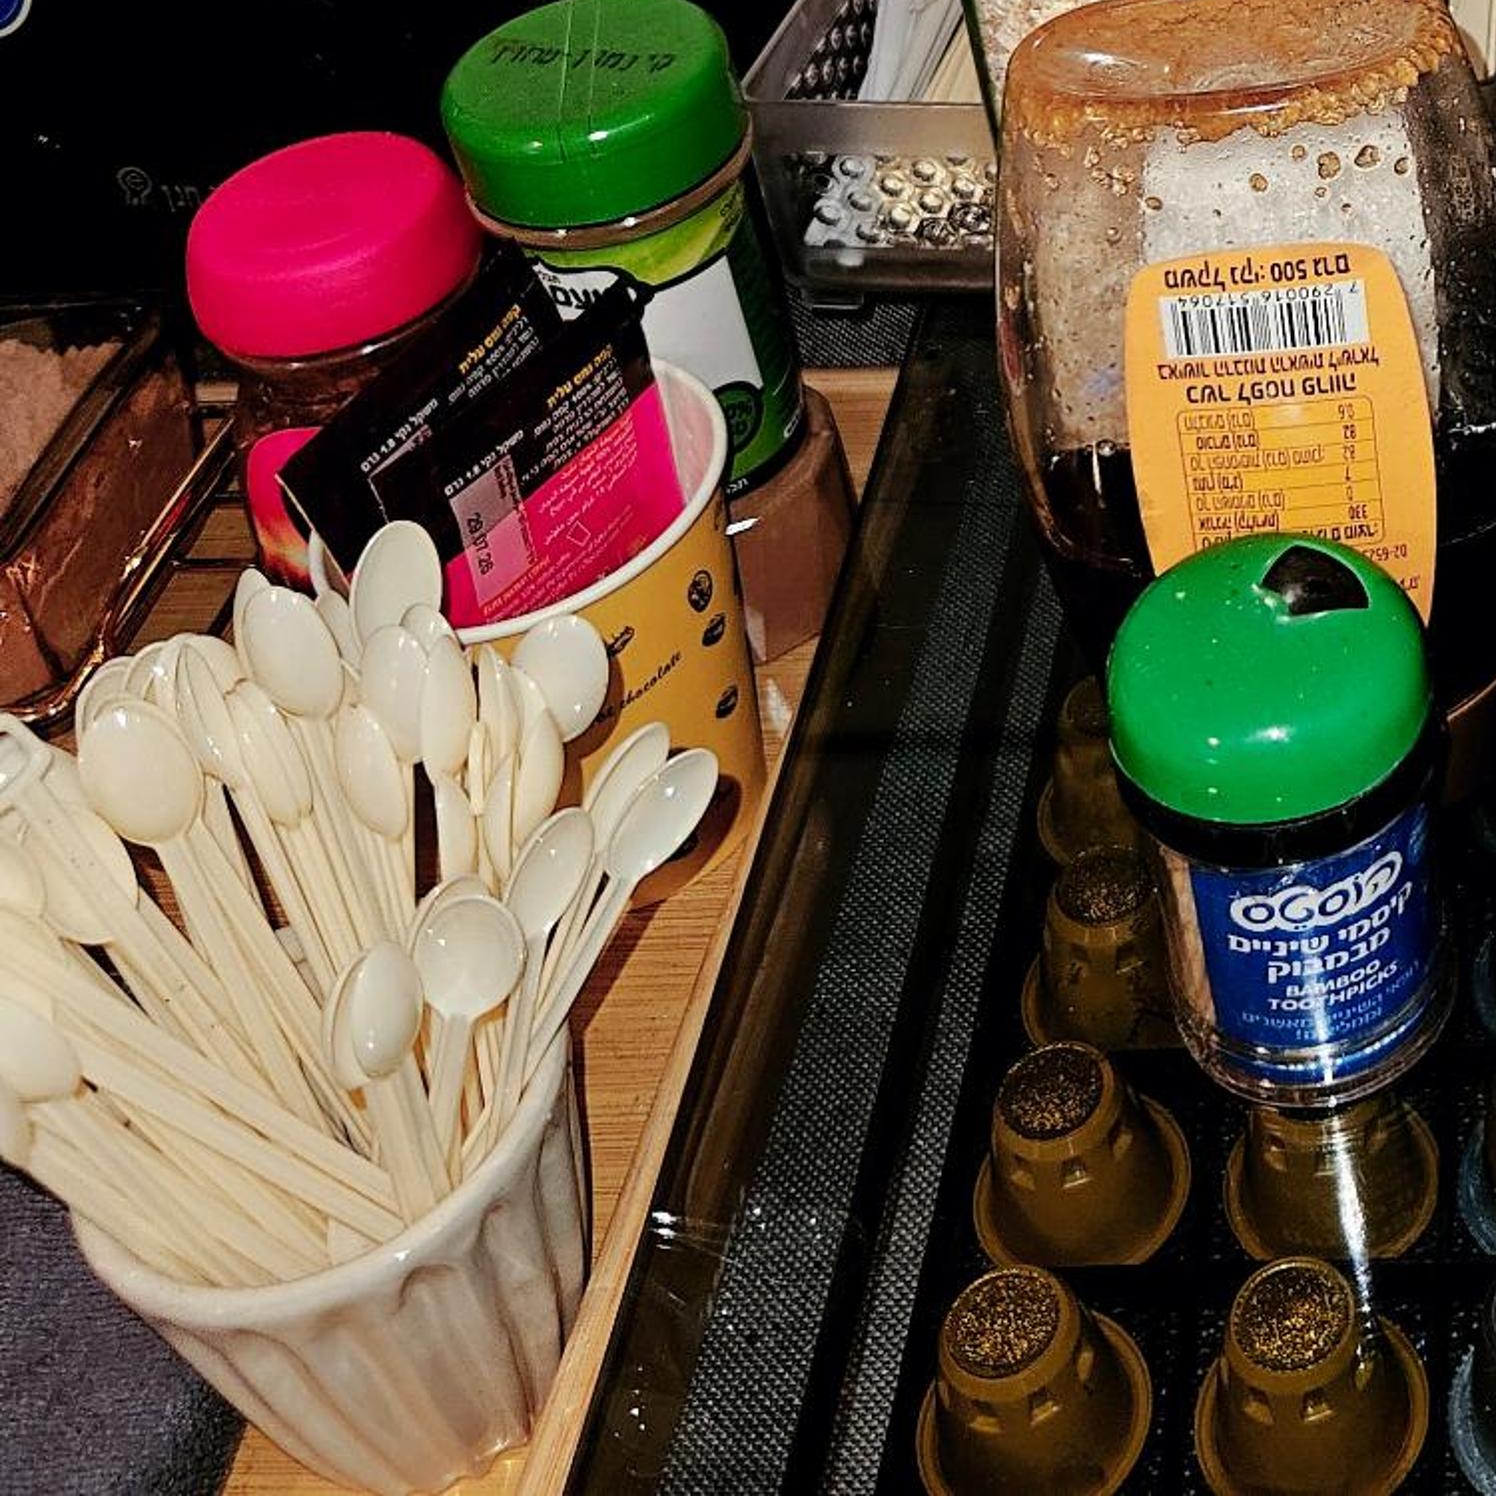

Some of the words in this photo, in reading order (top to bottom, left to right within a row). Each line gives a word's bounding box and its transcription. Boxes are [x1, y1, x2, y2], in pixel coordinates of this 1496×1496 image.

[1164, 260, 1226, 291] משקל
[1231, 257, 1265, 285] נקי:
[1270, 260, 1308, 282] 500
[1314, 253, 1351, 277] גרם
[1157, 362, 1209, 380] באישור
[1214, 357, 1267, 377] הרבנות
[1270, 352, 1324, 374] הראשית
[1328, 346, 1380, 372] לישראל
[1186, 383, 1232, 404] כשר
[1238, 379, 1296, 405] לפסח
[1302, 372, 1357, 397] פרווה
[408, 395, 438, 430] משקל
[395, 421, 411, 444] נקי
[496, 427, 523, 457] משקל
[360, 449, 379, 473] גרם
[480, 449, 496, 470] נקי
[444, 474, 463, 496] גרם
[620, 652, 681, 709] chocolate
[1338, 881, 1413, 941] קיסמי
[1228, 935, 1330, 957] שיניים
[1267, 927, 1391, 984] מבמבוק
[1268, 960, 1398, 1010] TOOTHPICKS
[1286, 959, 1381, 998] BAMBOO
